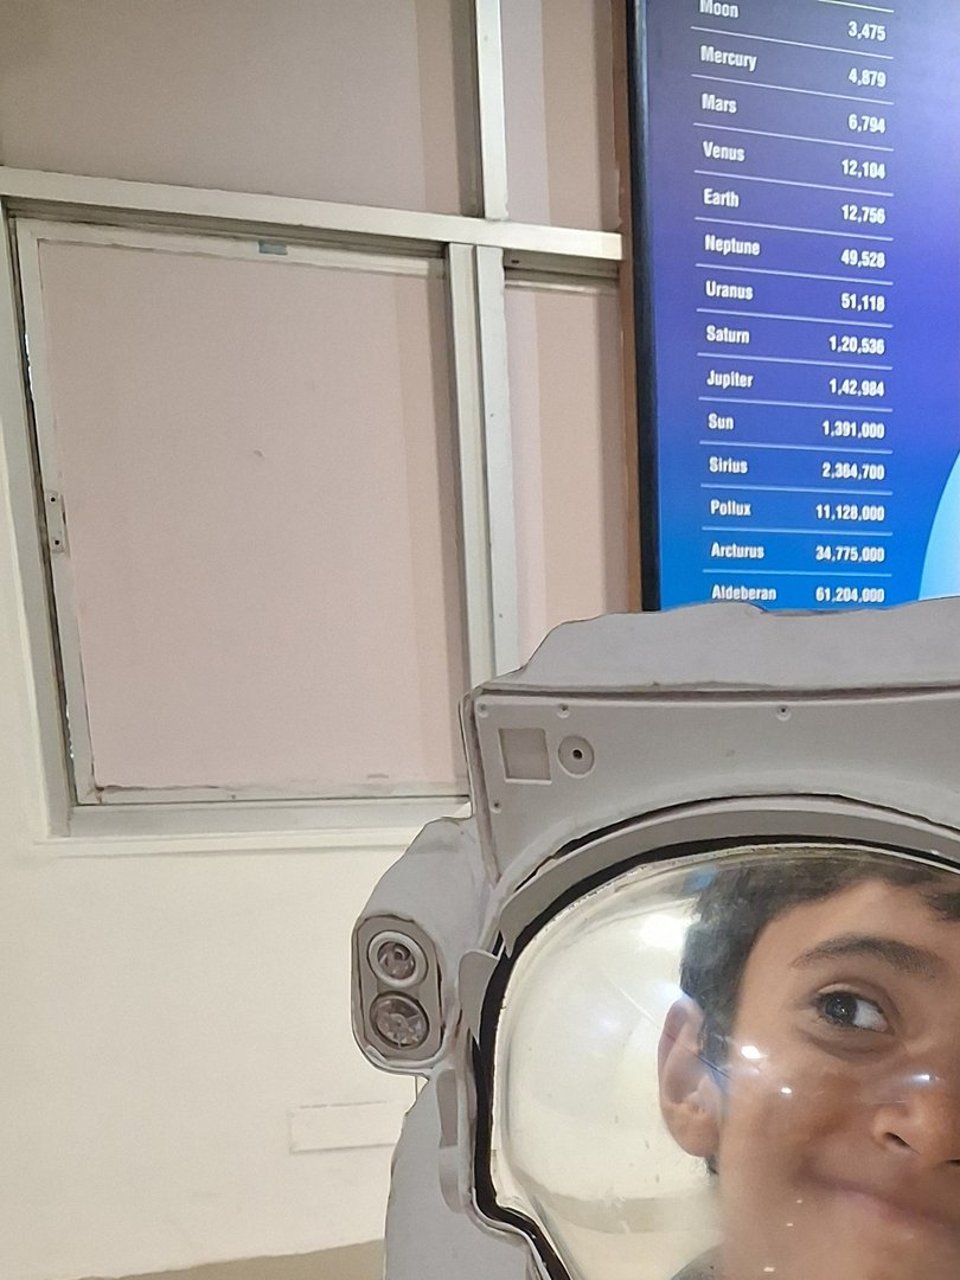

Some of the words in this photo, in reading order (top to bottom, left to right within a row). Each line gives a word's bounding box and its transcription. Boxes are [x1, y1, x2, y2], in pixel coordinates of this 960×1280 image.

[699, 0, 739, 18] Moon
[848, 20, 886, 41] 3,475
[700, 45, 757, 72] Mercury
[848, 68, 886, 88] 4,879
[702, 93, 737, 114] Mars
[848, 113, 886, 134] 6,794
[702, 140, 745, 162] Venus
[841, 159, 886, 179] 12,104
[703, 188, 739, 208] Earth
[841, 204, 886, 224] 12,756
[704, 234, 760, 256] Neptune
[841, 249, 886, 269] 49,528
[705, 280, 753, 300] Uranus
[841, 292, 885, 312] 51,118
[706, 325, 750, 344] Saturn
[829, 335, 885, 355] 1,20,536
[706, 369, 754, 389] Jupiter
[829, 378, 885, 397] 1,42,984
[708, 413, 734, 430] Sun
[822, 420, 885, 439] 1,391,000
[709, 456, 748, 474] Sirius
[710, 499, 751, 516] Pollux
[815, 504, 885, 521] 11,128,000
[711, 542, 765, 559] Arcturus
[815, 545, 885, 562] 34,775,000
[711, 584, 777, 601] Aldeberan
[815, 586, 885, 603] 61,204,000
